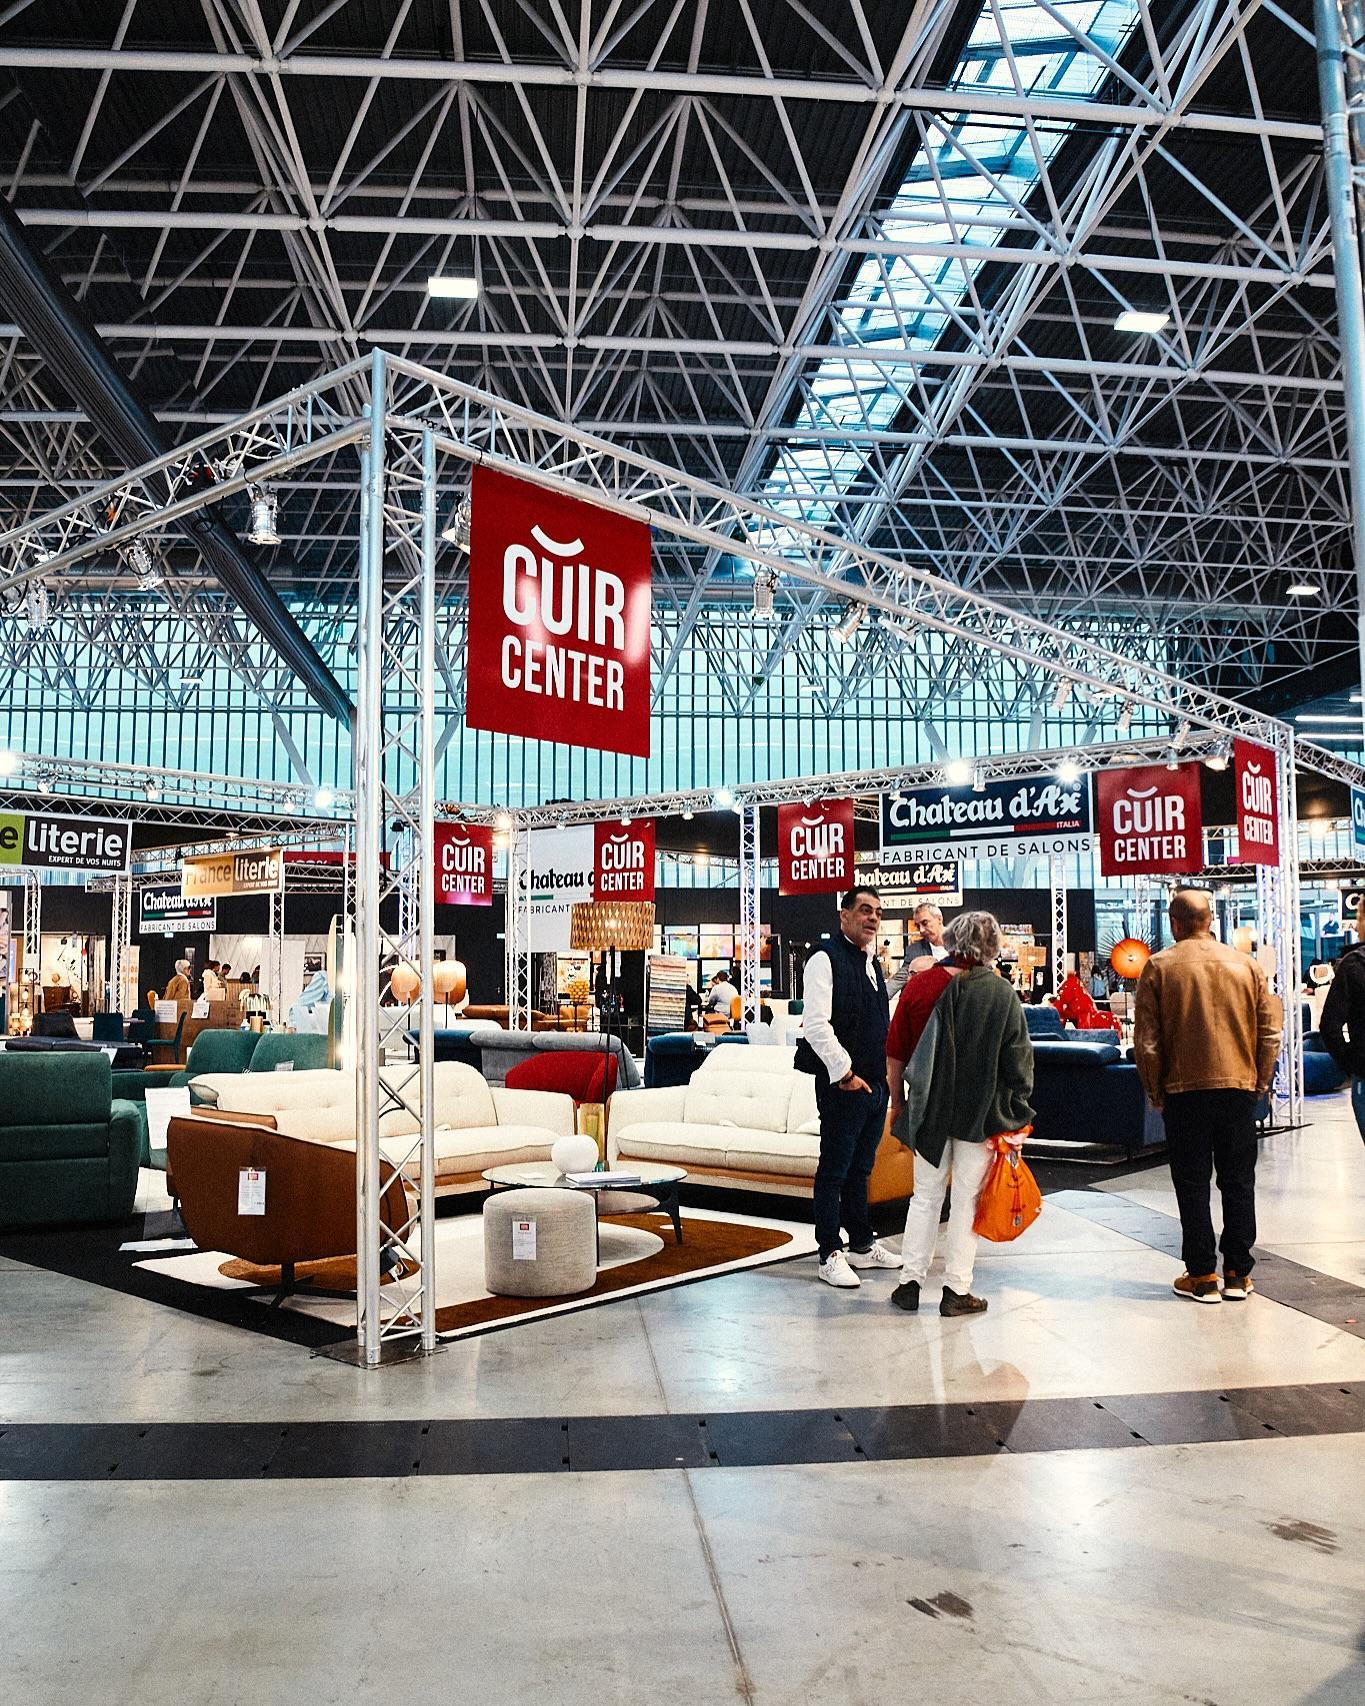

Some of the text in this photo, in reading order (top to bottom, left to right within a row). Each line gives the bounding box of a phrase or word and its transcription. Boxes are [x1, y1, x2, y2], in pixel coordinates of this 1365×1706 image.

[502, 635, 624, 711] CENTER
[889, 794, 1003, 827] Chateau
[1056, 820, 1080, 829] ITALIA
[1243, 815, 1273, 845] CENTER
[28, 820, 123, 857] literie
[882, 838, 1090, 863] FABRICANT DE SALONS
[1114, 835, 1186, 862] CENTER
[48, 855, 73, 864] EXPERT
[76, 857, 84, 865] DE
[102, 859, 121, 867] NUITS
[235, 856, 279, 881] literie
[791, 857, 845, 880] CENTER
[442, 873, 485, 894] CENTER
[601, 871, 644, 892] CENTER
[854, 867, 911, 888] hateau
[188, 921, 215, 930] SALONS
